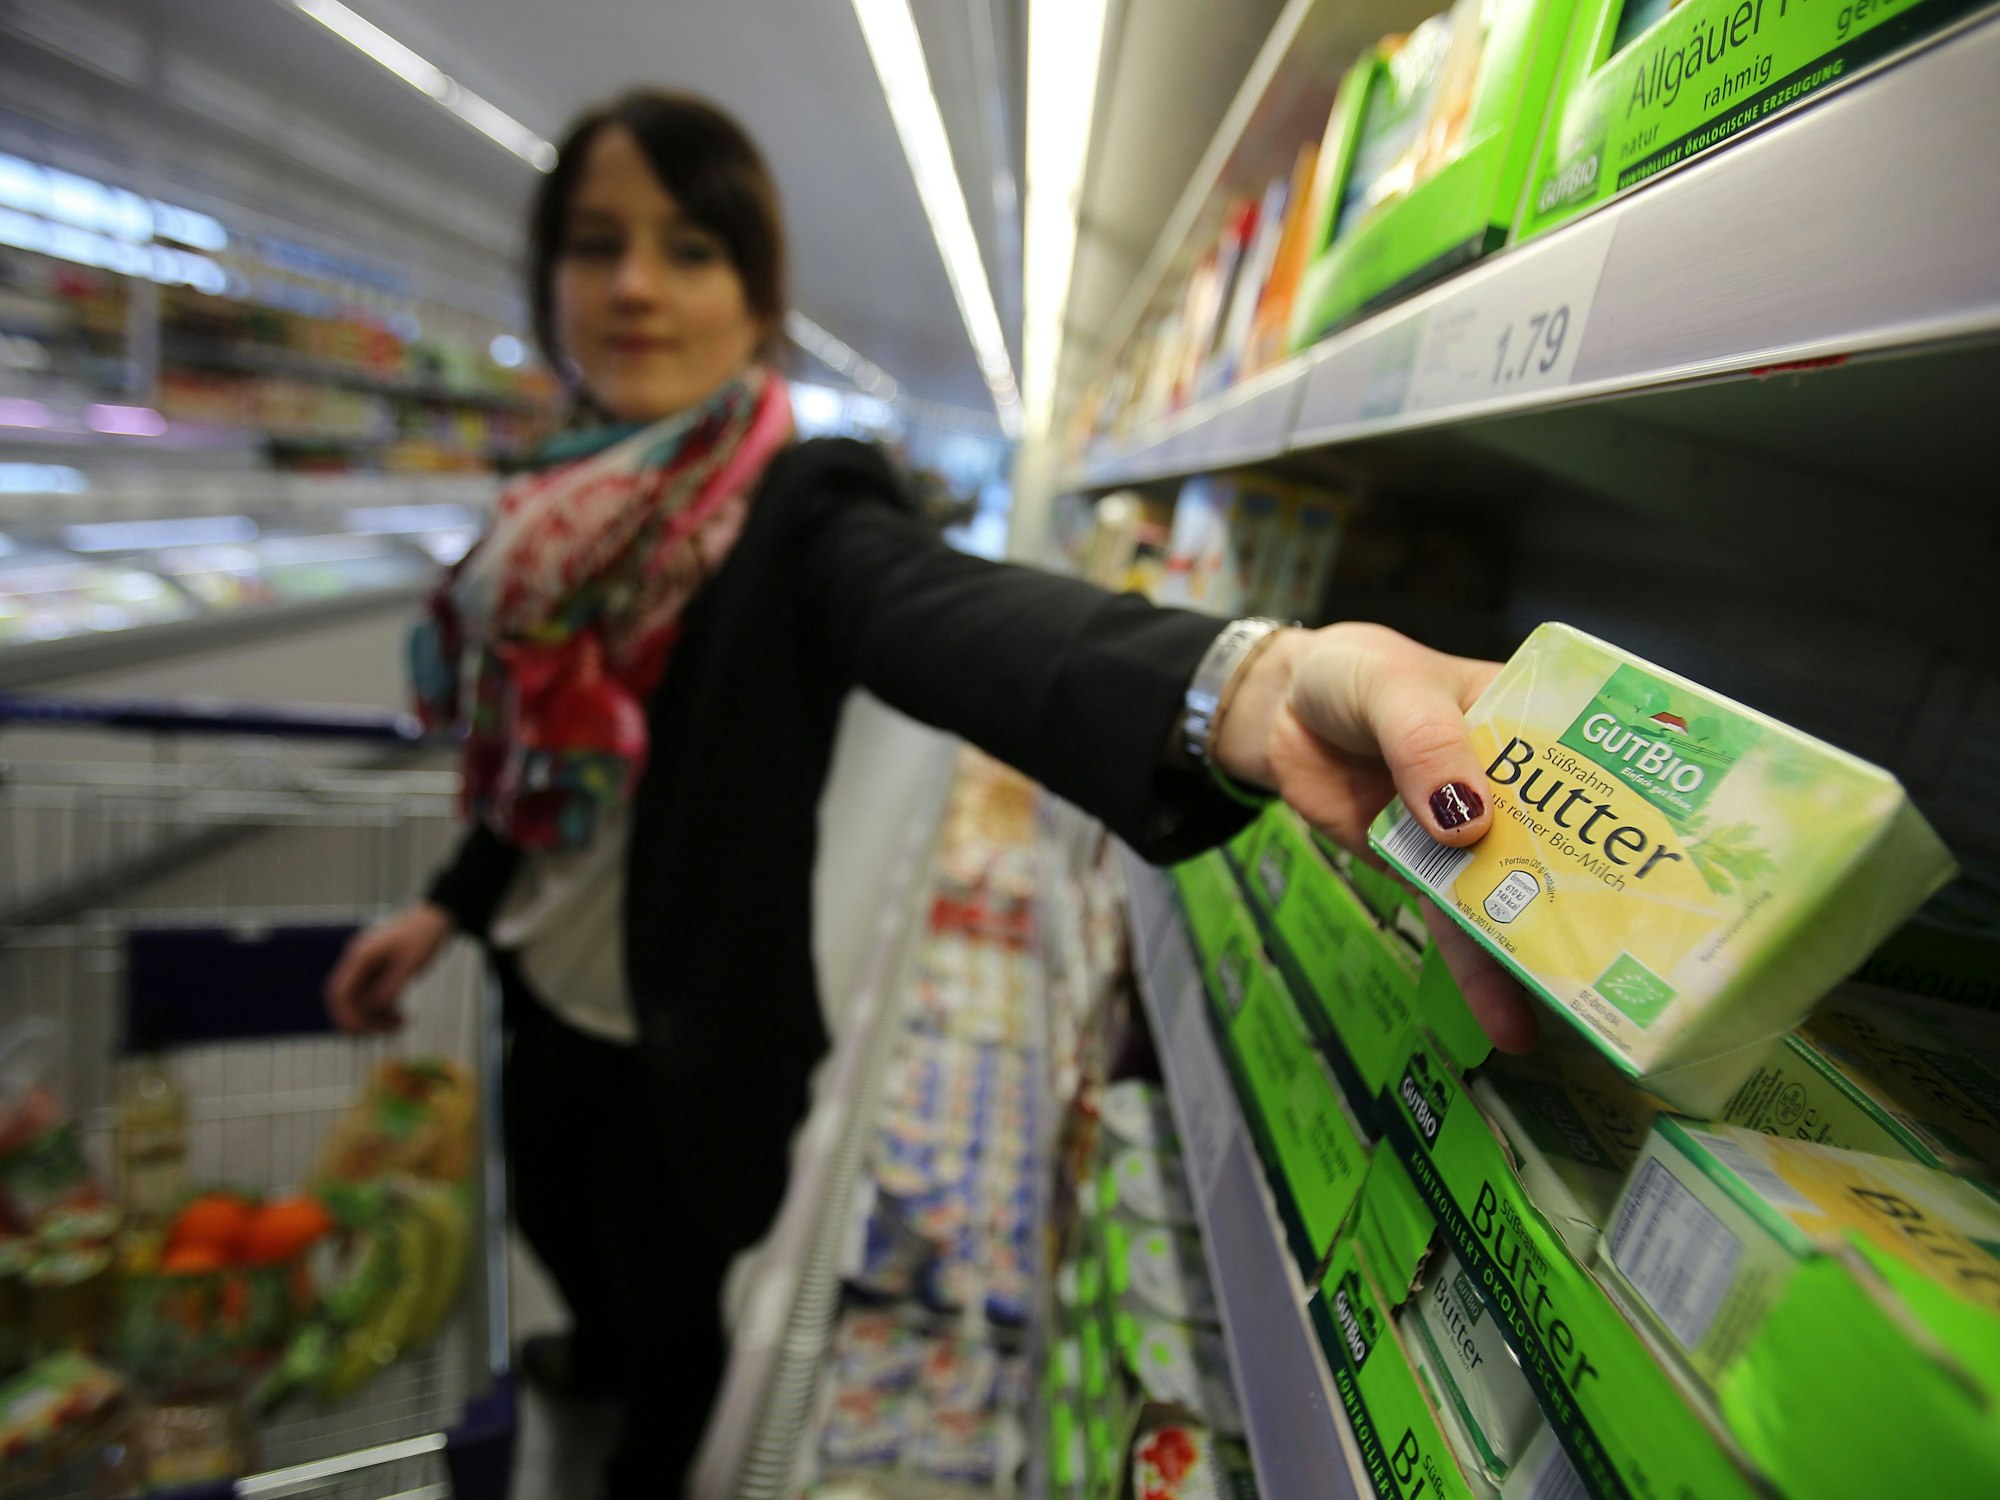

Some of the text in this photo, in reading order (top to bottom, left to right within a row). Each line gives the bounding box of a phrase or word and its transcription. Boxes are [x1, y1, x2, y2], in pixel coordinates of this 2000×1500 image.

[1703, 53, 1773, 112] rahmig
[1619, 60, 1844, 190] KONTROLLIERT ÖKOLOGISCHE ERZEUGUNG
[1620, 123, 1660, 160] natur
[1492, 304, 1571, 387] 1.79
[1541, 746, 1615, 799] Süßrahm
[1582, 711, 1705, 795] GUTBIO
[1620, 767, 1654, 790] Einfach
[1485, 736, 1684, 880] Butter
[1492, 794, 1626, 892] us reiner Bio-Milch
[1504, 856, 1530, 866] Portion
[1496, 890, 1521, 912] 148 kcal
[1505, 884, 1518, 897] 610
[1509, 873, 1537, 896] Brennwert
[1461, 902, 1472, 916] 100
[1474, 915, 1488, 930] 3051
[1495, 932, 1507, 946] 742
[1504, 939, 1519, 954] kcal
[1402, 1076, 1437, 1139] GUTBIO
[1500, 1198, 1549, 1277] Süßrahm
[1411, 1150, 1482, 1268] KONTROLLIERT
[1482, 1262, 1572, 1425] ÖKOLOGISCHE
[1471, 1179, 1599, 1392] Butter
[1434, 1276, 1484, 1370] Butter
